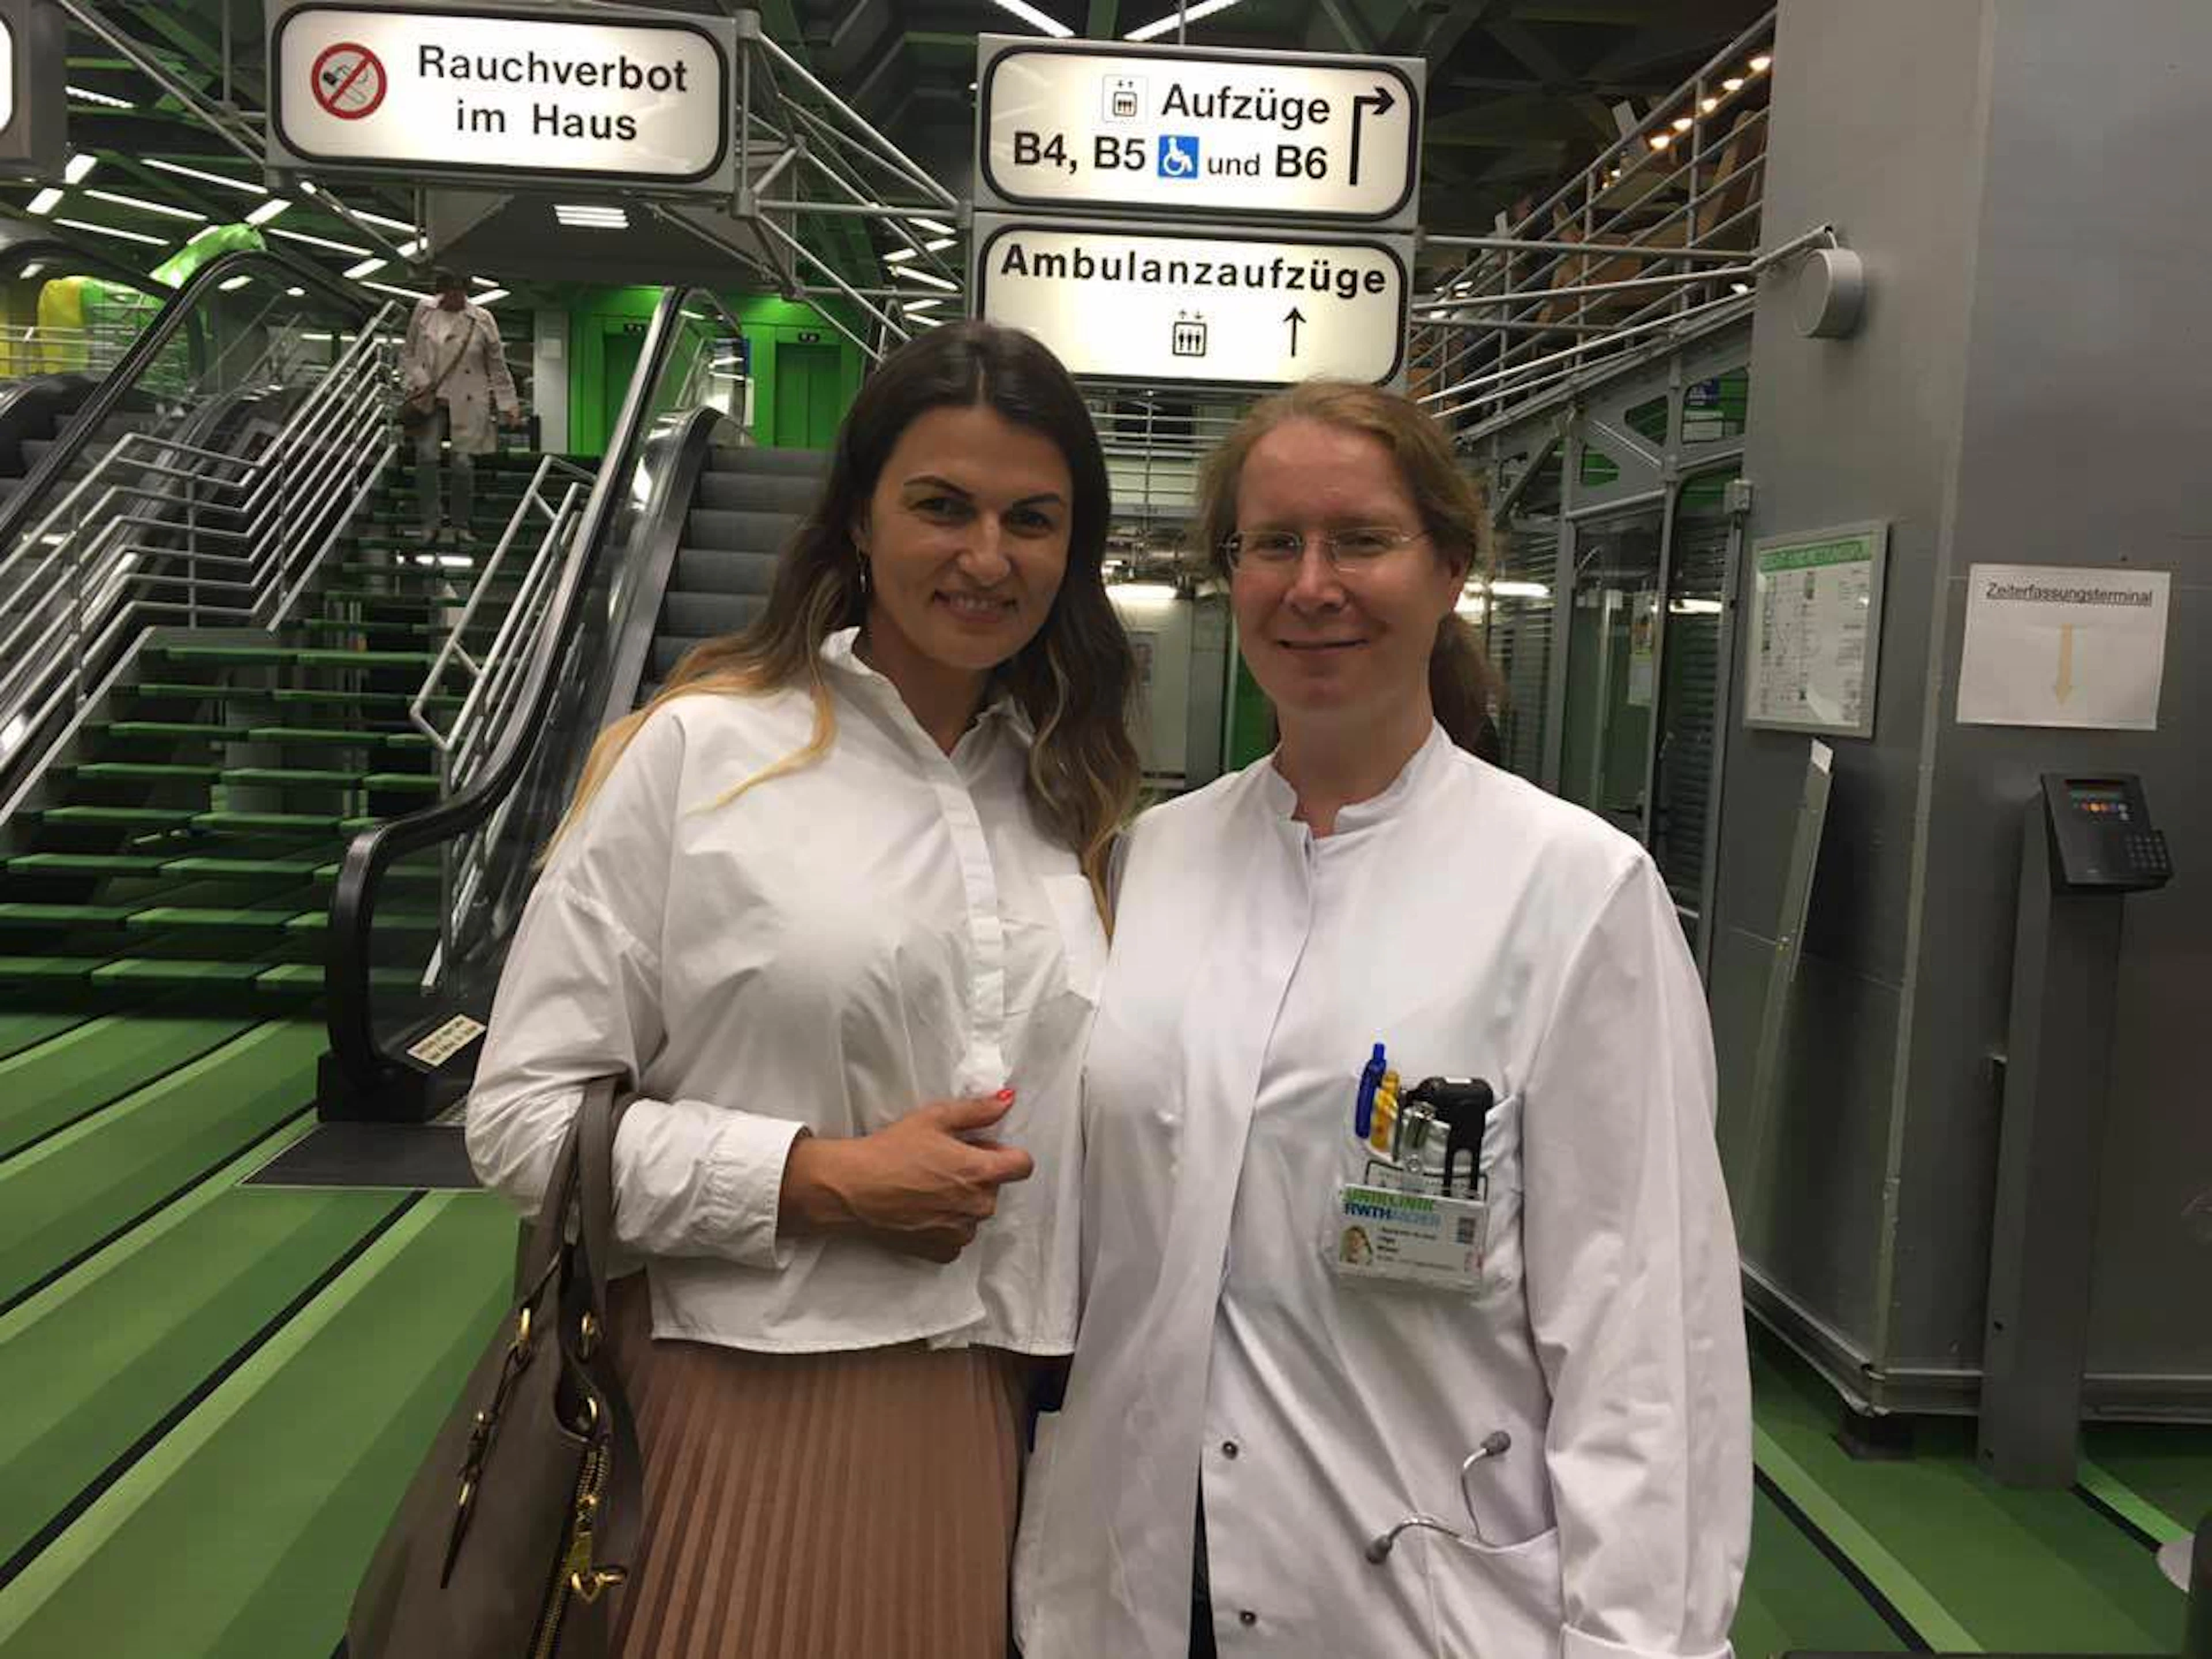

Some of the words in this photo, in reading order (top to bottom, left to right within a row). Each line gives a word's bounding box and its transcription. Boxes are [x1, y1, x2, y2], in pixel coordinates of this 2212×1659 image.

[419, 44, 688, 93] Rauchverbot
[457, 99, 505, 133] im
[532, 104, 637, 141] Haus
[1161, 83, 1331, 131] Aufzüge
[1013, 131, 1078, 175] B4,
[1093, 136, 1146, 171] B5
[1207, 153, 1260, 177] und
[1275, 144, 1328, 180] B6
[999, 243, 1387, 300] Ambulanzaufzüge
[1986, 582, 2153, 605] Zeiterfassungsterminal
